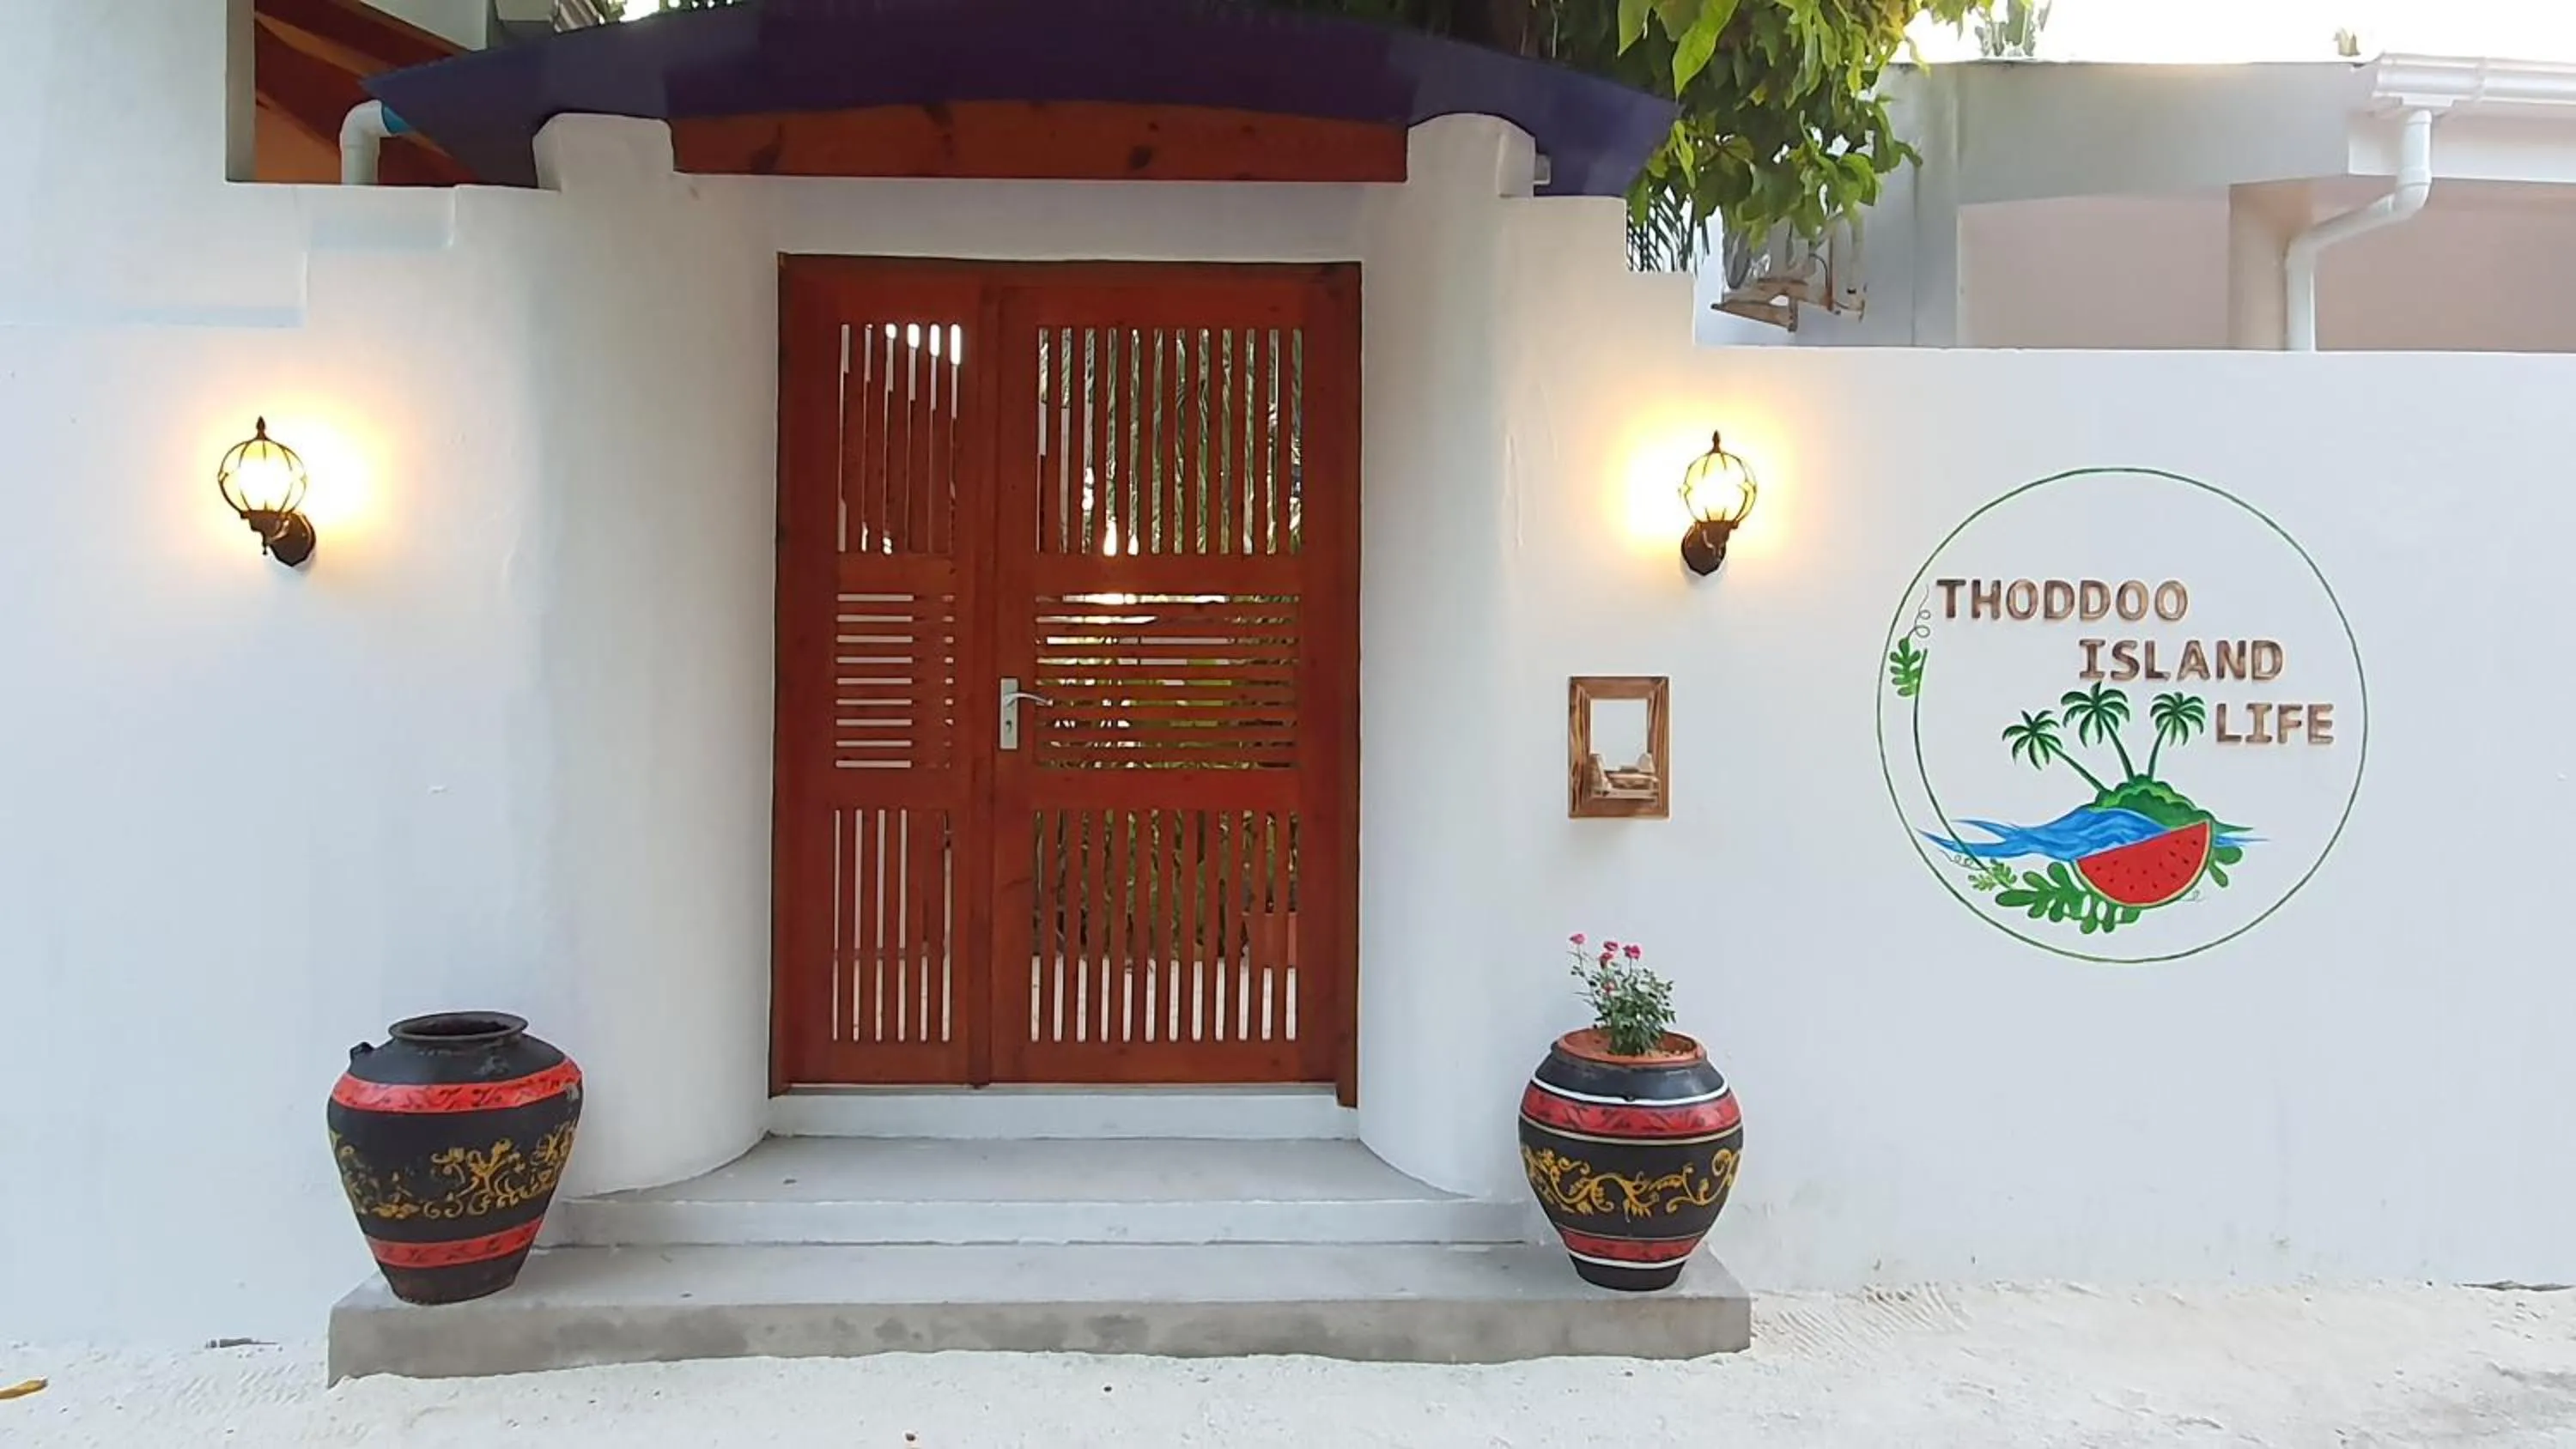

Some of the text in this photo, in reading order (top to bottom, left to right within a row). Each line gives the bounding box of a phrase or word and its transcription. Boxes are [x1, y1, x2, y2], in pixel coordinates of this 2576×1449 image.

[1936, 579, 2189, 621] THODDOO
[2079, 640, 2284, 682] ISLAND
[2216, 703, 2334, 744] LIFE
